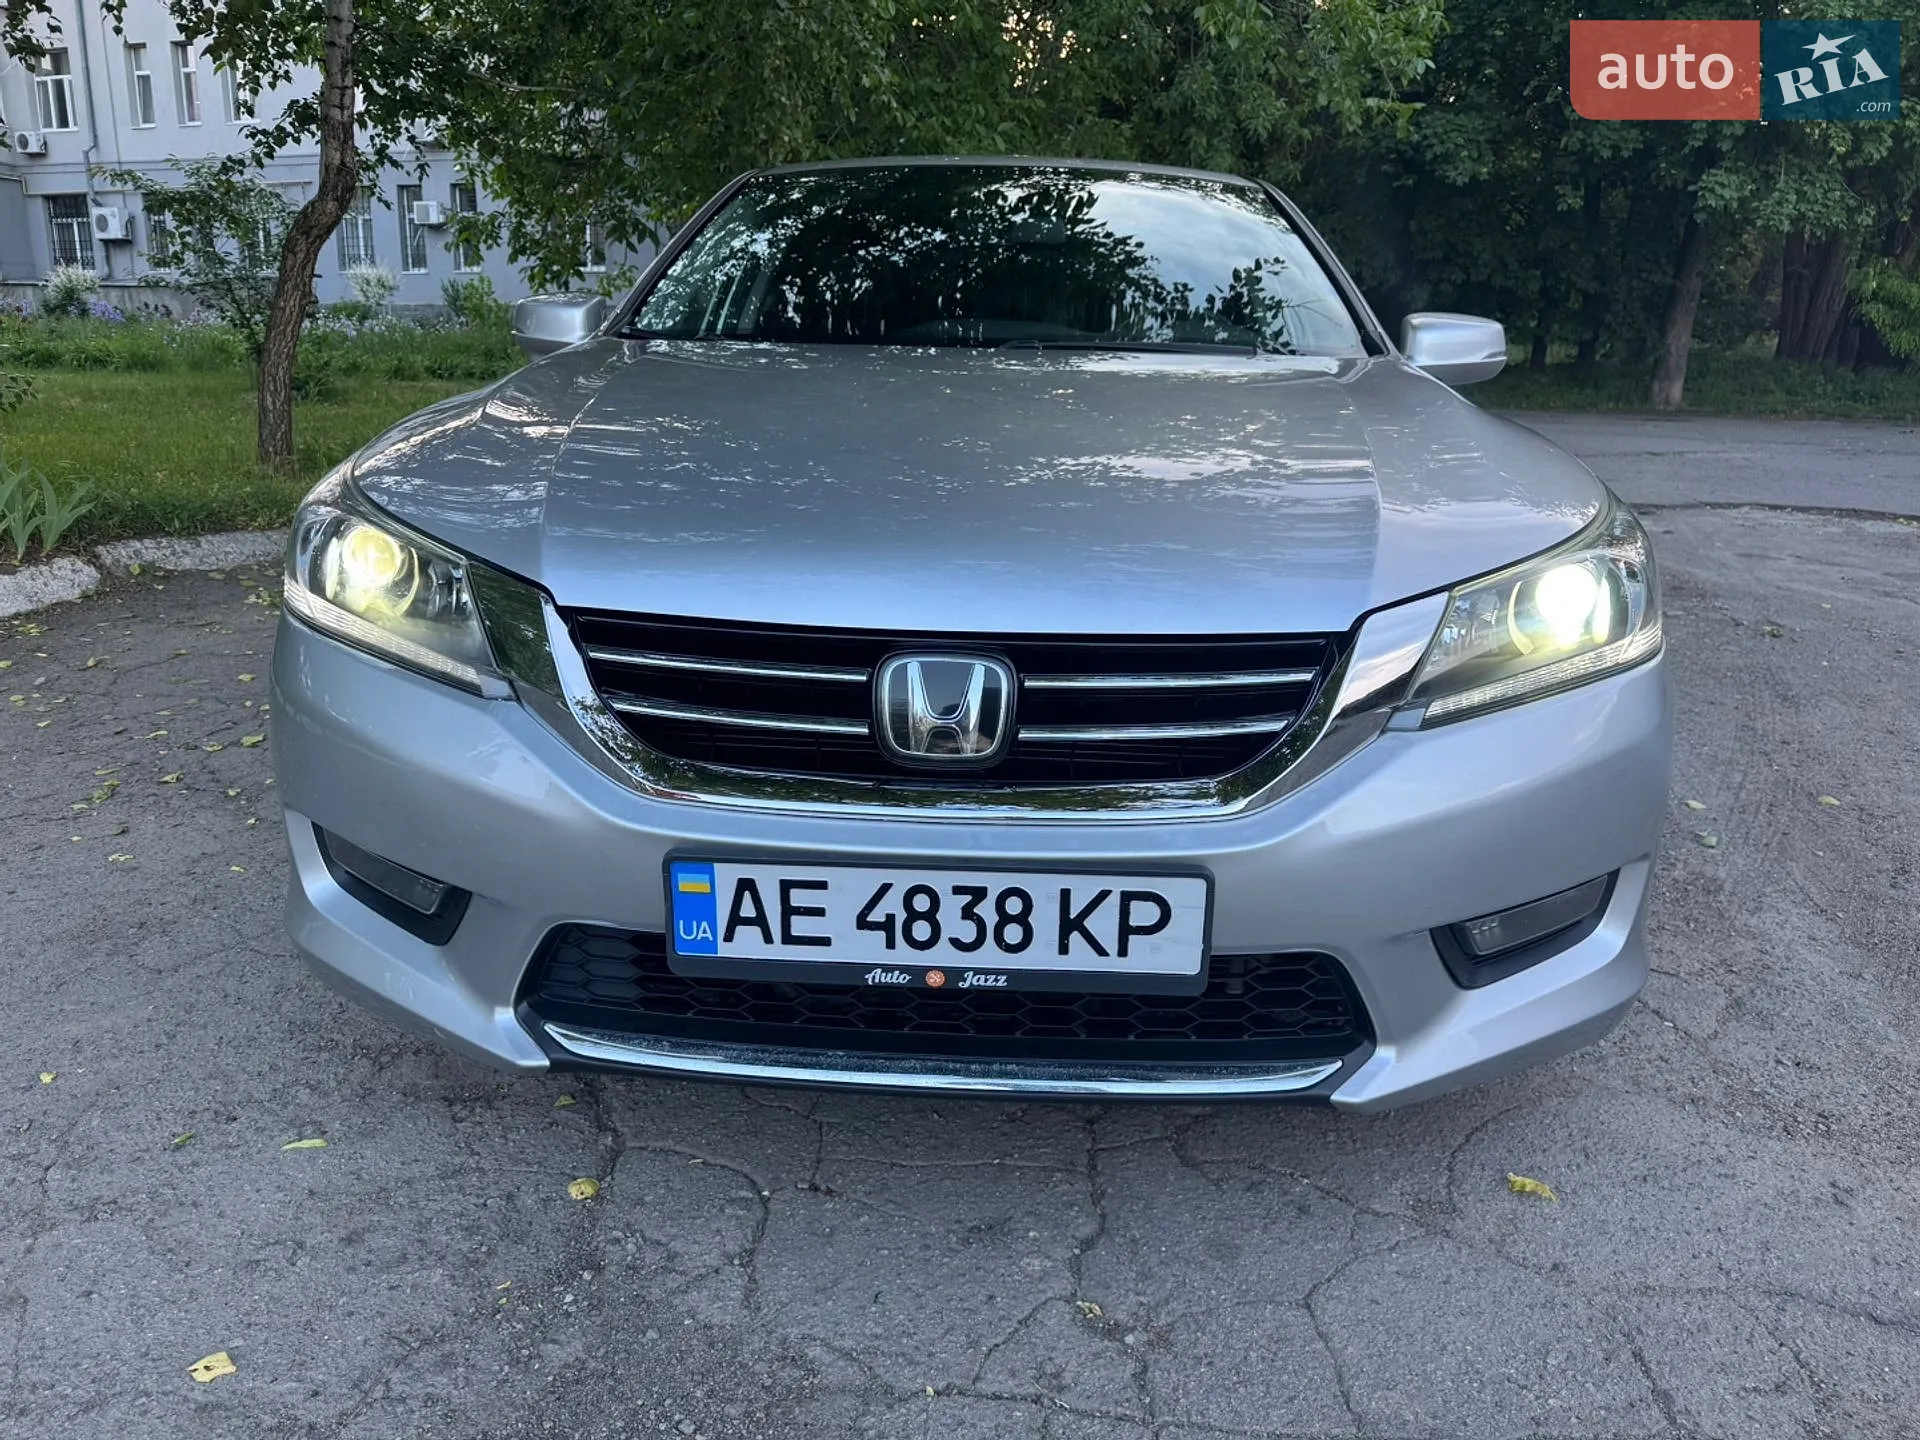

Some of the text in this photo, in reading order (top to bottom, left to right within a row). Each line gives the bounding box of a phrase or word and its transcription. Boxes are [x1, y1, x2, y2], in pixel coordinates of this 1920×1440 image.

[722, 877, 1172, 958] AE 4838 KP
[679, 919, 713, 941] UA
[864, 968, 1008, 988] Auto Jazz
